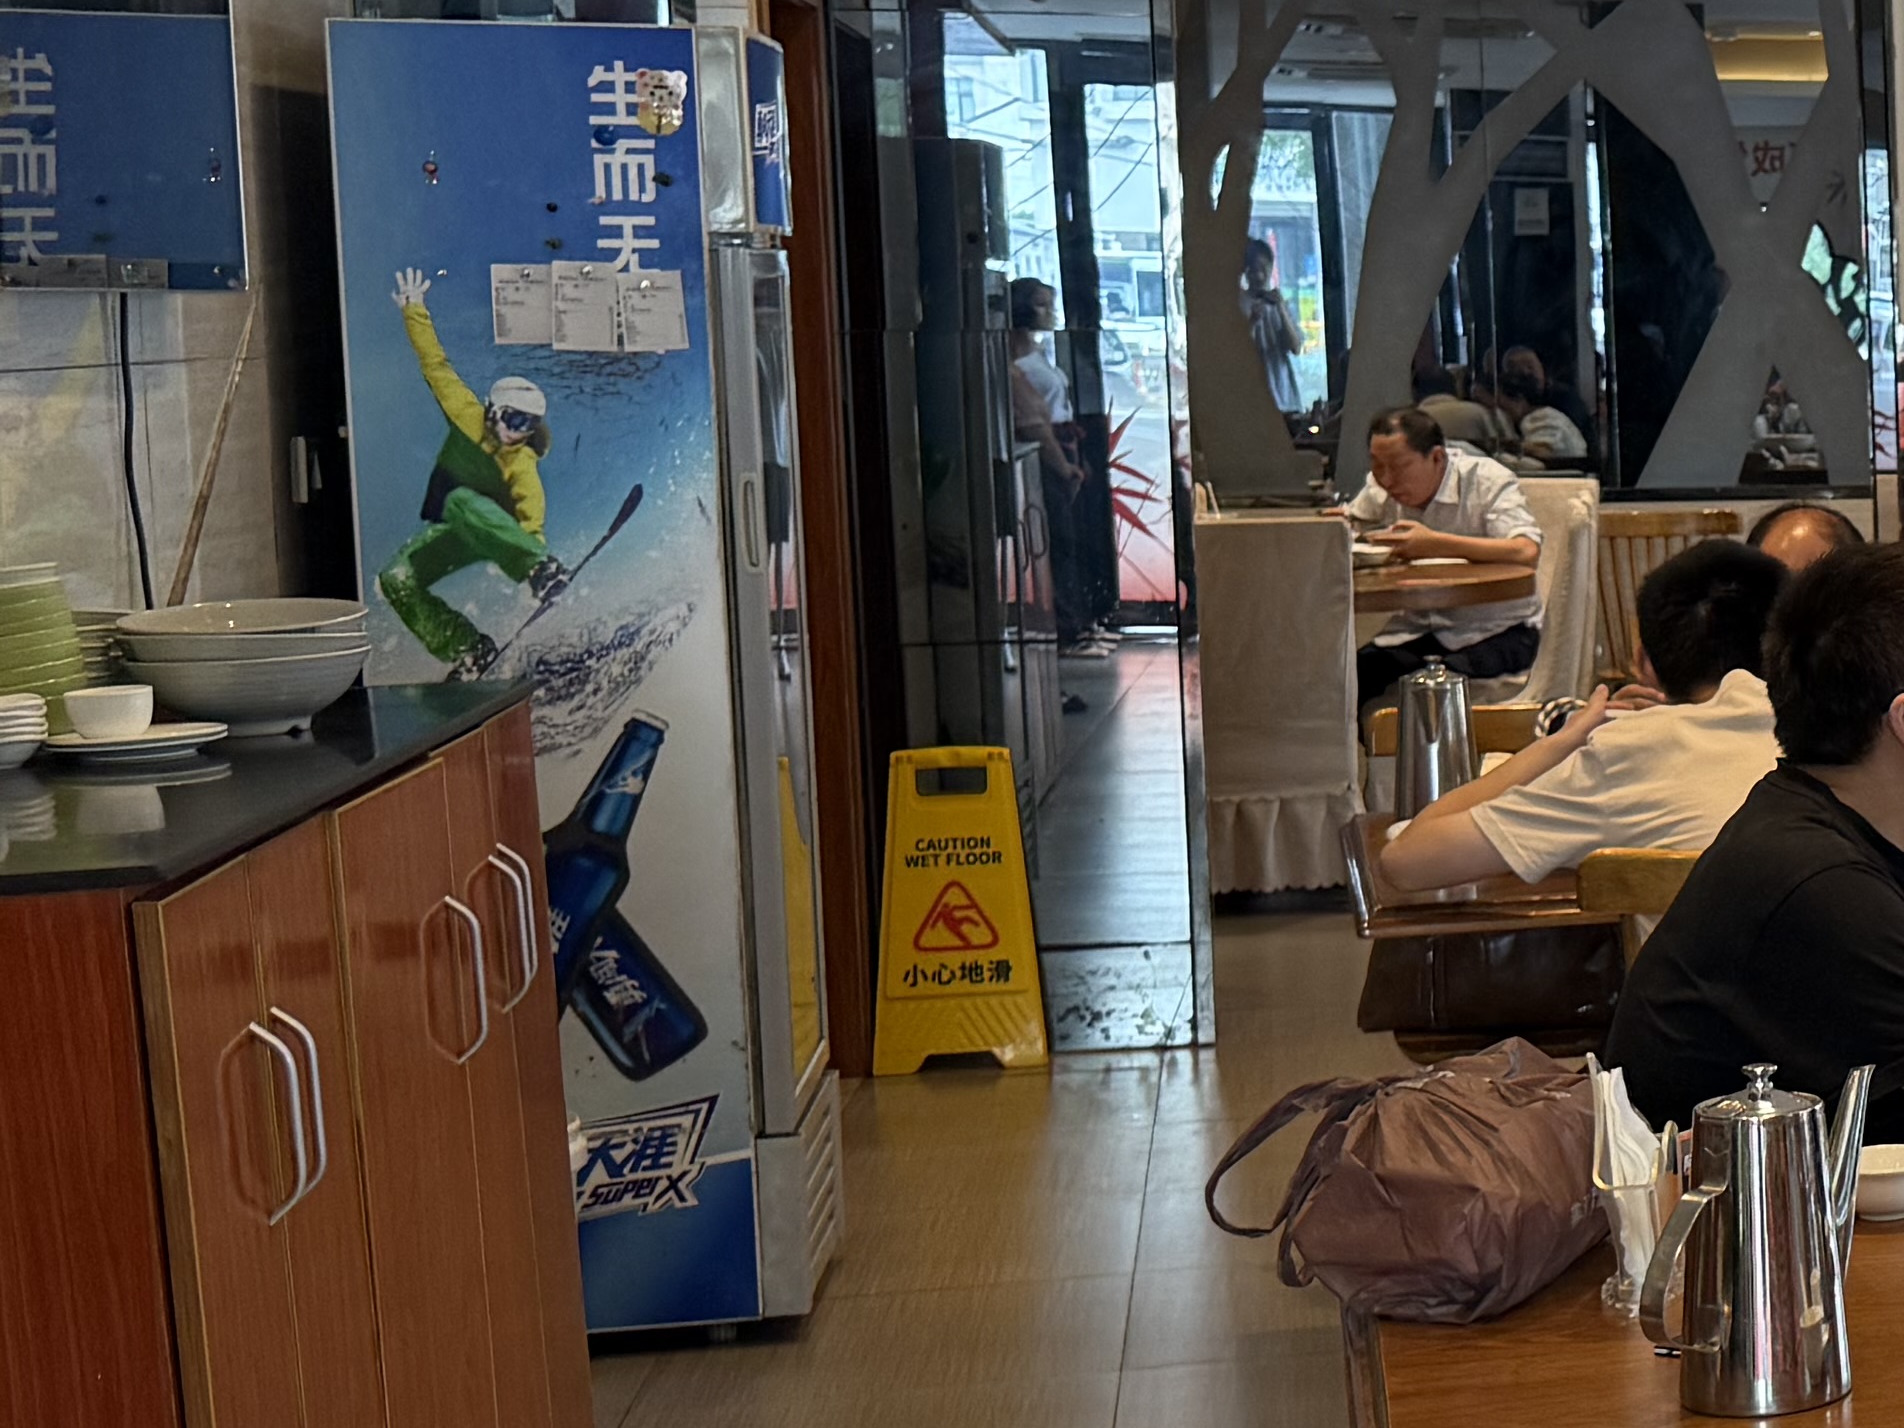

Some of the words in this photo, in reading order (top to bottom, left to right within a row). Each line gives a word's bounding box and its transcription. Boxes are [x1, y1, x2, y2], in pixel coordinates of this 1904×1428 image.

[913, 835, 991, 853] CAUTION
[904, 852, 941, 869] WET
[945, 850, 1003, 867] FLOOR
[902, 959, 1013, 988] 小心地滑
